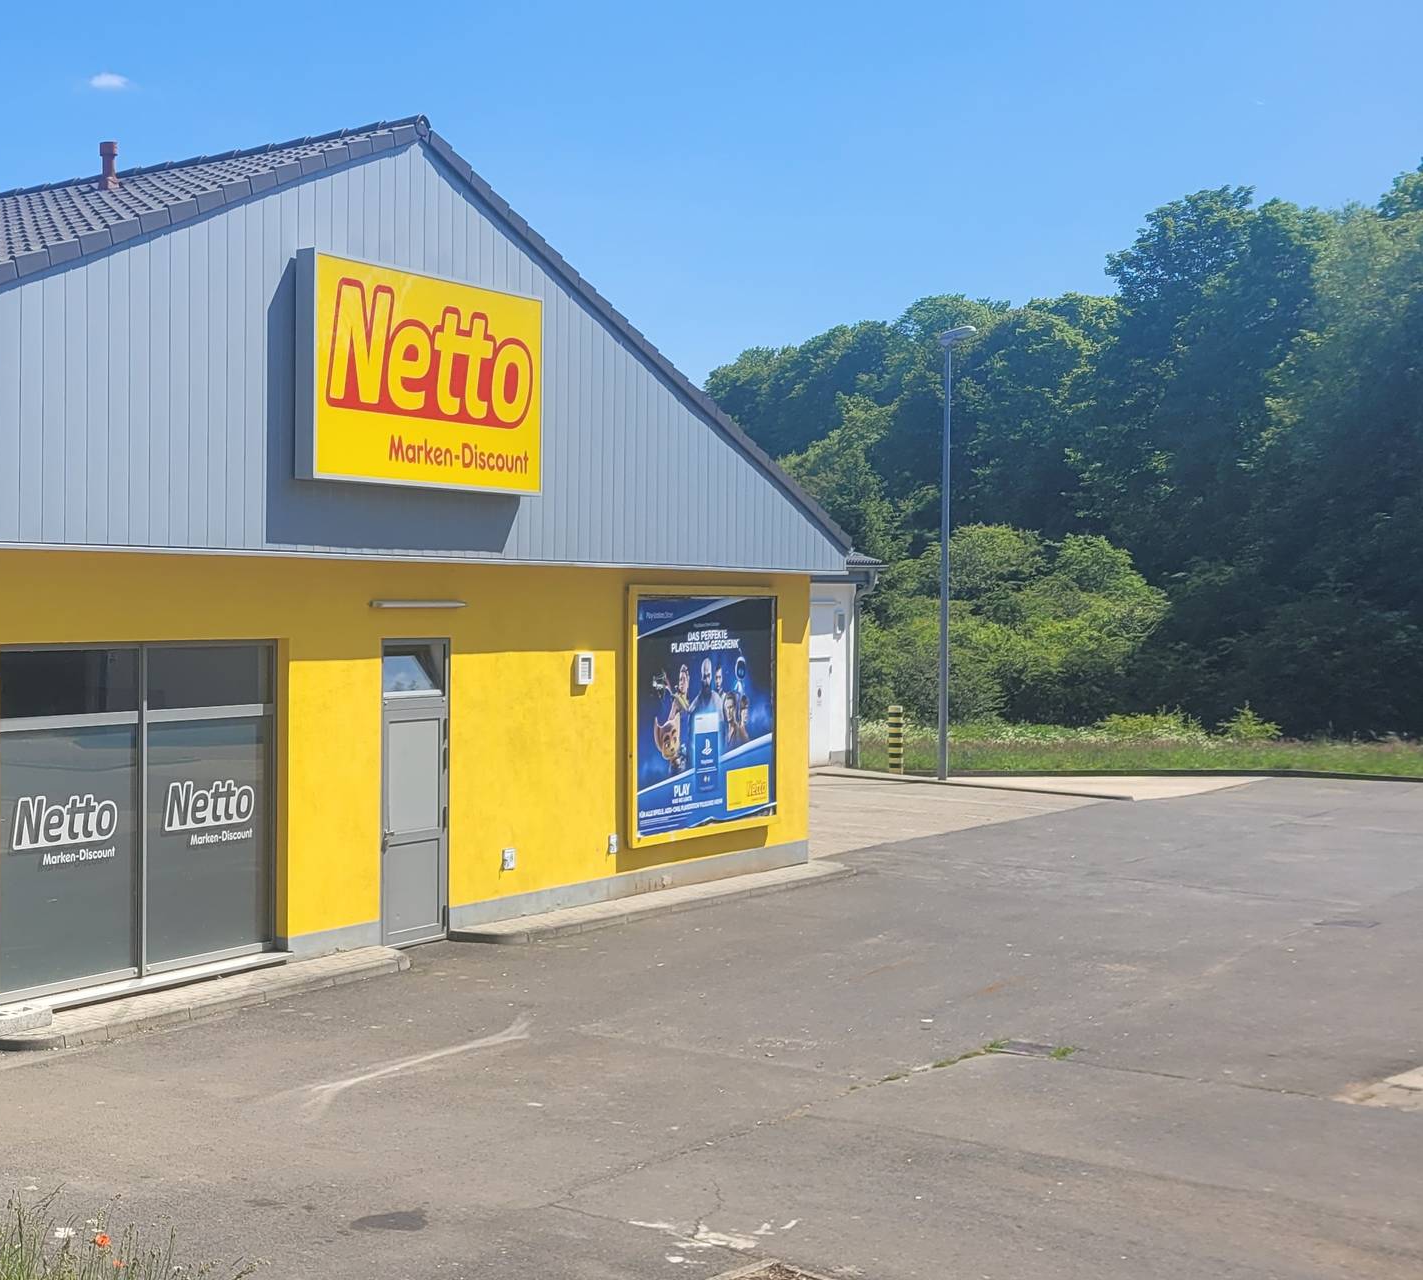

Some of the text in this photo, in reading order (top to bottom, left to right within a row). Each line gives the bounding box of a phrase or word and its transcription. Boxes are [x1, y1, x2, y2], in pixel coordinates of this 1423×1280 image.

[326, 277, 533, 429] Netto
[388, 434, 530, 475] Marken-Discount
[687, 629, 729, 642] DAS PERFEKTE
[671, 639, 740, 654] PLAYSTATION-GESCHENK
[673, 783, 690, 797] PLAY
[165, 780, 254, 831] Netto
[13, 794, 117, 850] Netto
[190, 828, 253, 846] Marken-Discount
[42, 846, 116, 866] Marken-Discount
